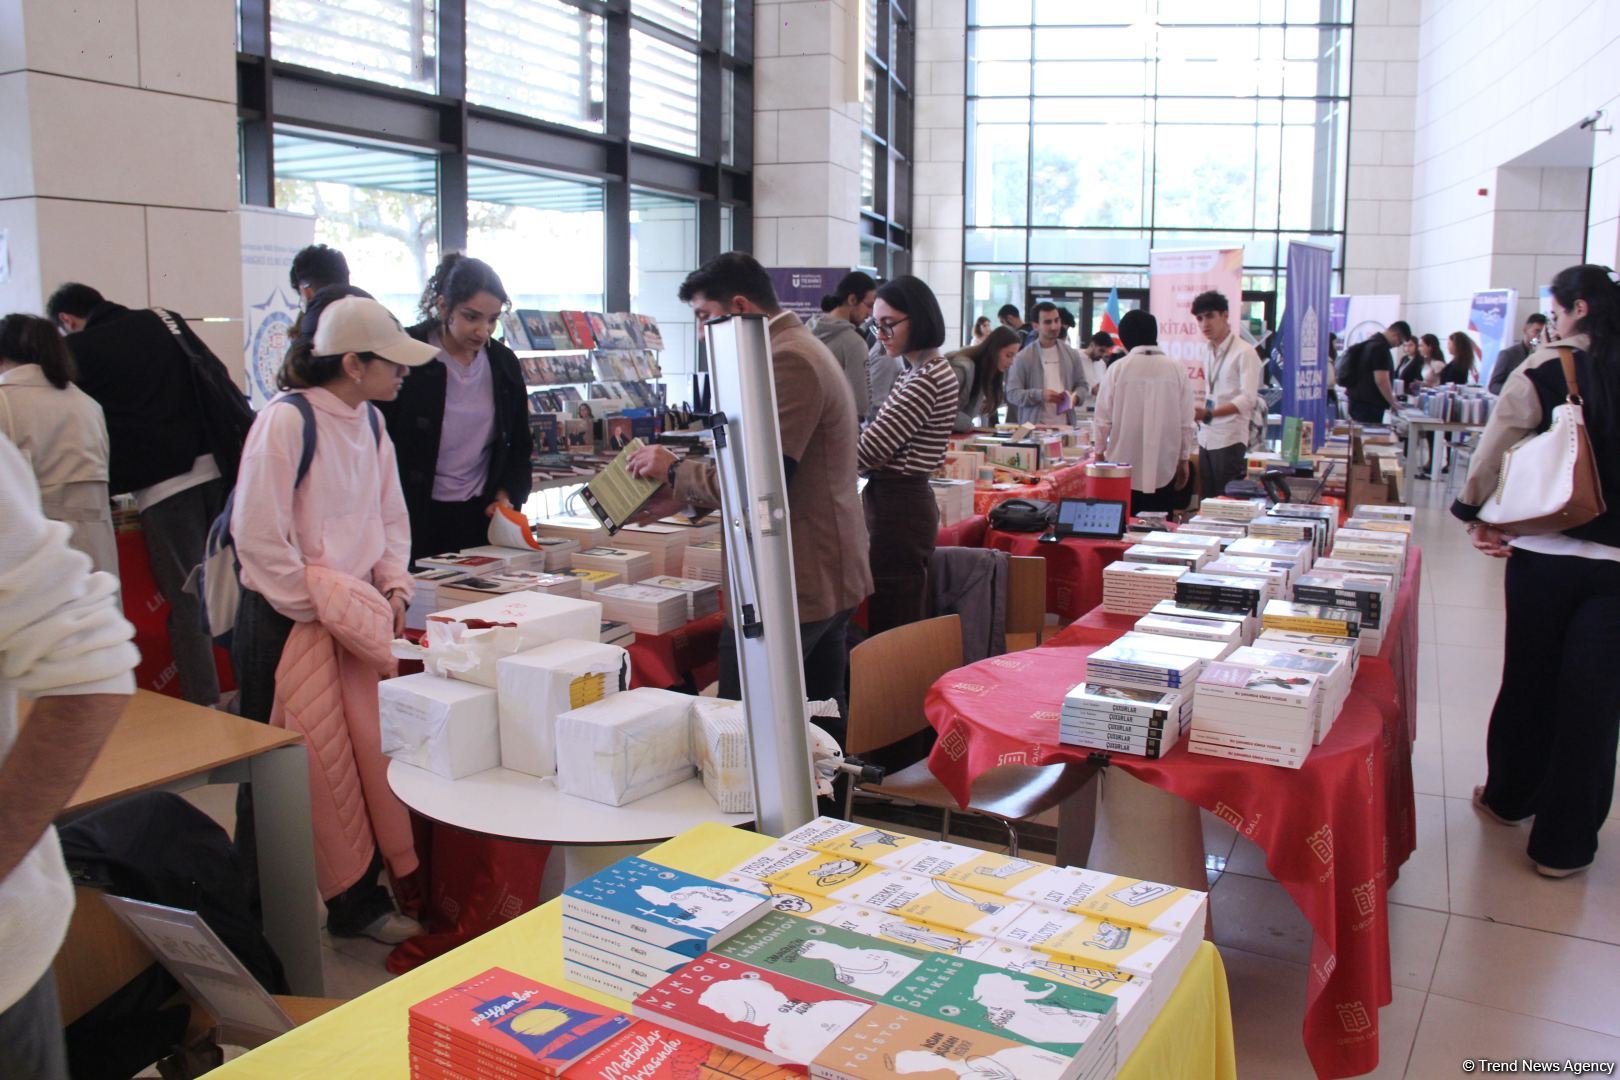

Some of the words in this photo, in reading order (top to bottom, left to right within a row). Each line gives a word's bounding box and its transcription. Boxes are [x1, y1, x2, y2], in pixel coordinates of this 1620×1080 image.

[1109, 713, 1133, 722] ÇUXURLAR
[1112, 704, 1137, 713] ÇUXURLAR
[1106, 733, 1131, 742] ÇUXURLAR
[1107, 723, 1132, 732] ÇUXURLAR
[1106, 742, 1130, 751] ÇUXURLAR
[737, 918, 798, 958] LERMONTOV
[646, 957, 718, 1004] VİKTOR
[892, 956, 948, 1005] ÇARLZ
[908, 961, 964, 1008] DİKKENS
[842, 1021, 880, 1052] LEV
[845, 1015, 910, 1069] TOLSTOY
